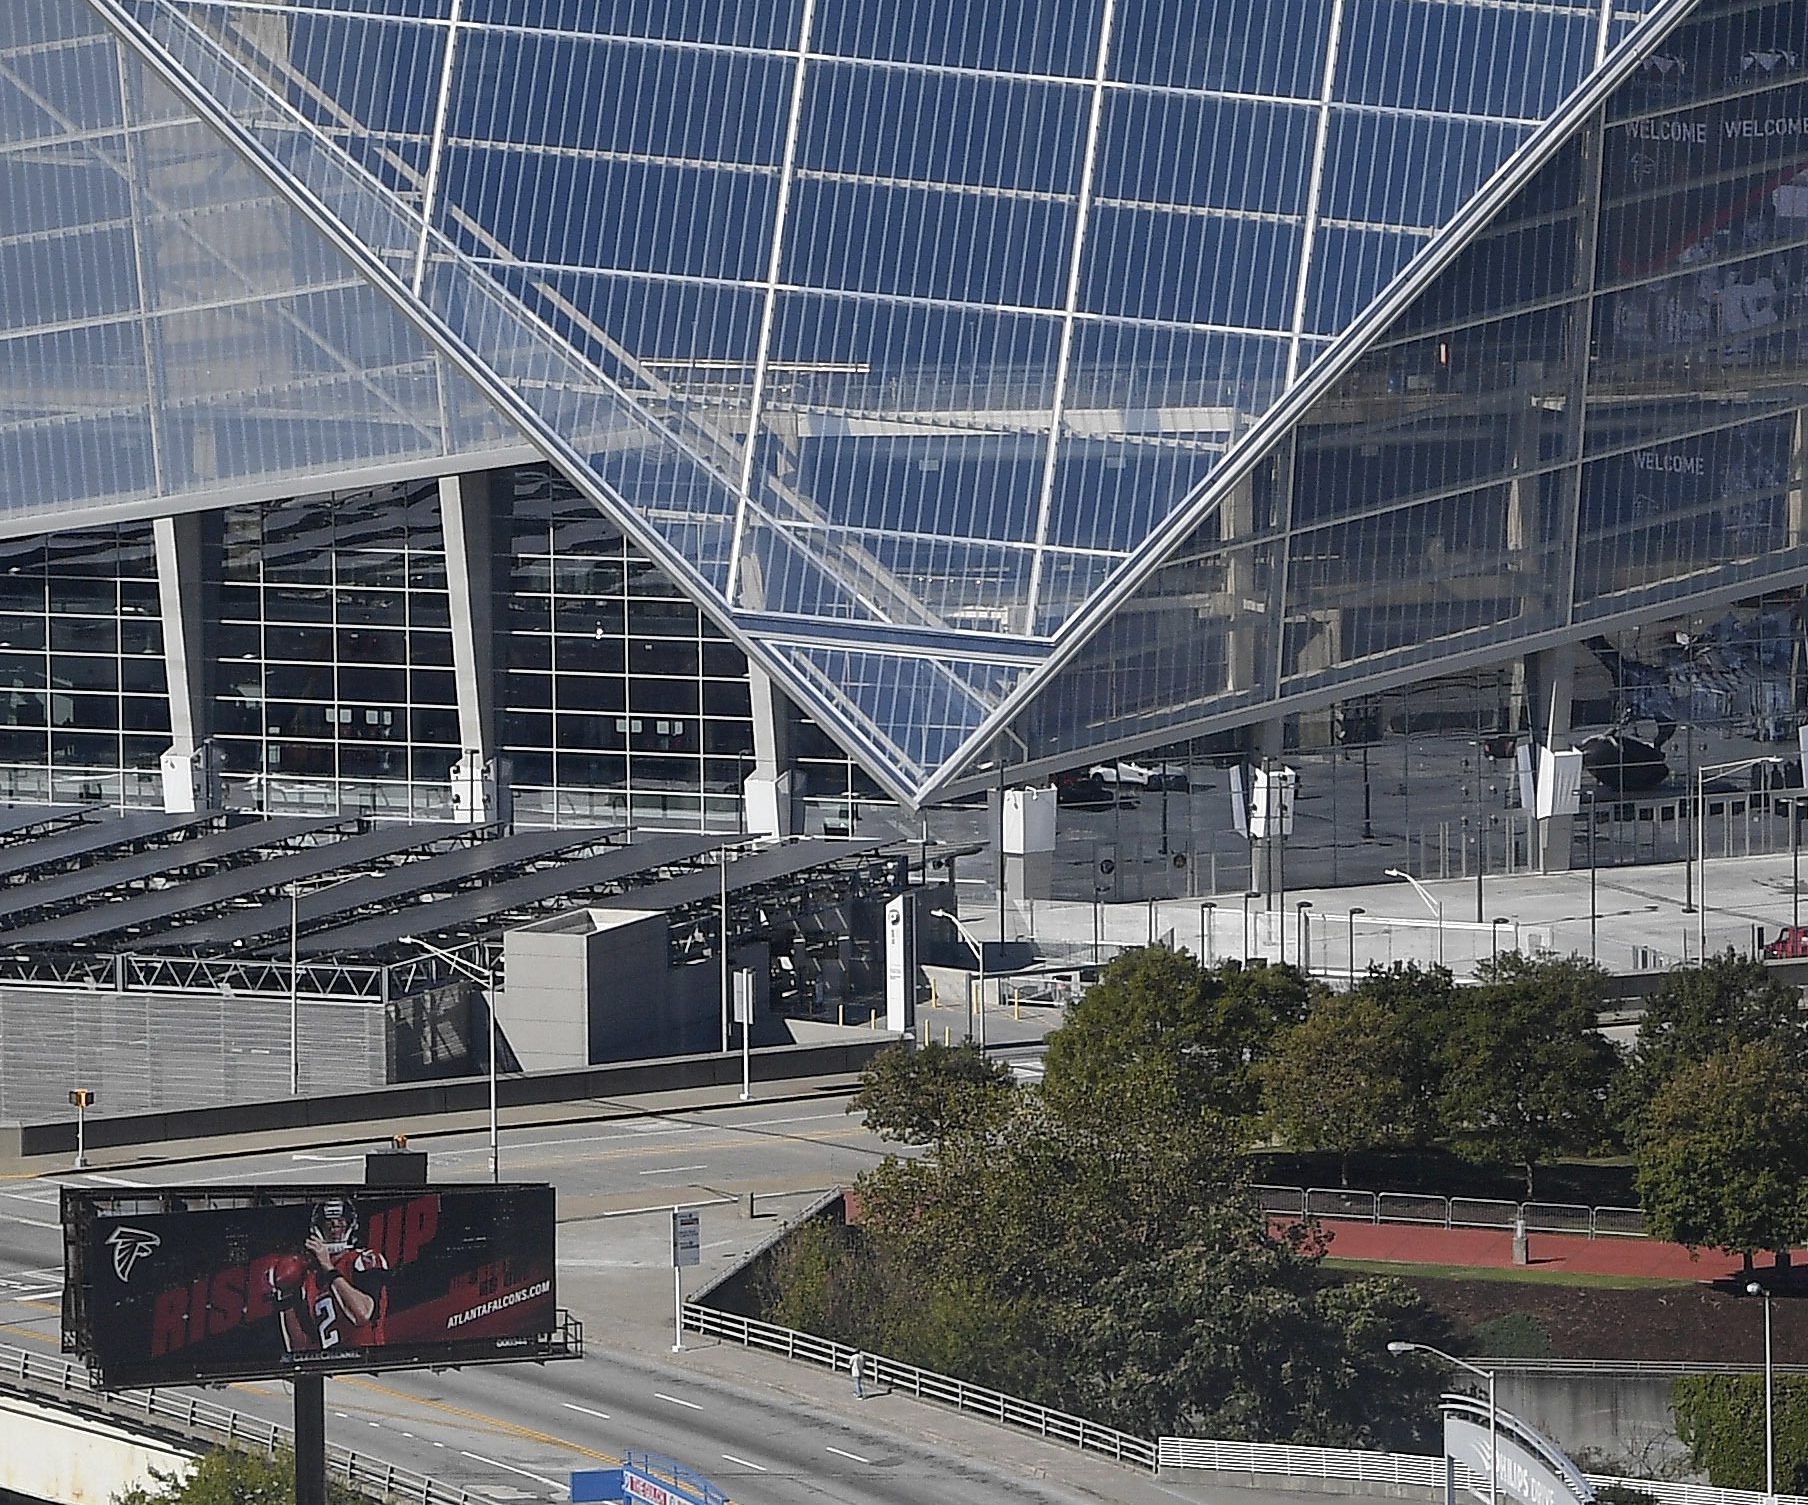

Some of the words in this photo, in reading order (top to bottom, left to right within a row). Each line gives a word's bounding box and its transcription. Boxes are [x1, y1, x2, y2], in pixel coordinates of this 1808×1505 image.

[1625, 119, 1707, 143] WELCOME
[1632, 451, 1704, 476] WELCOME
[446, 1279, 551, 1330] ATLANTAFALCONS.COM
